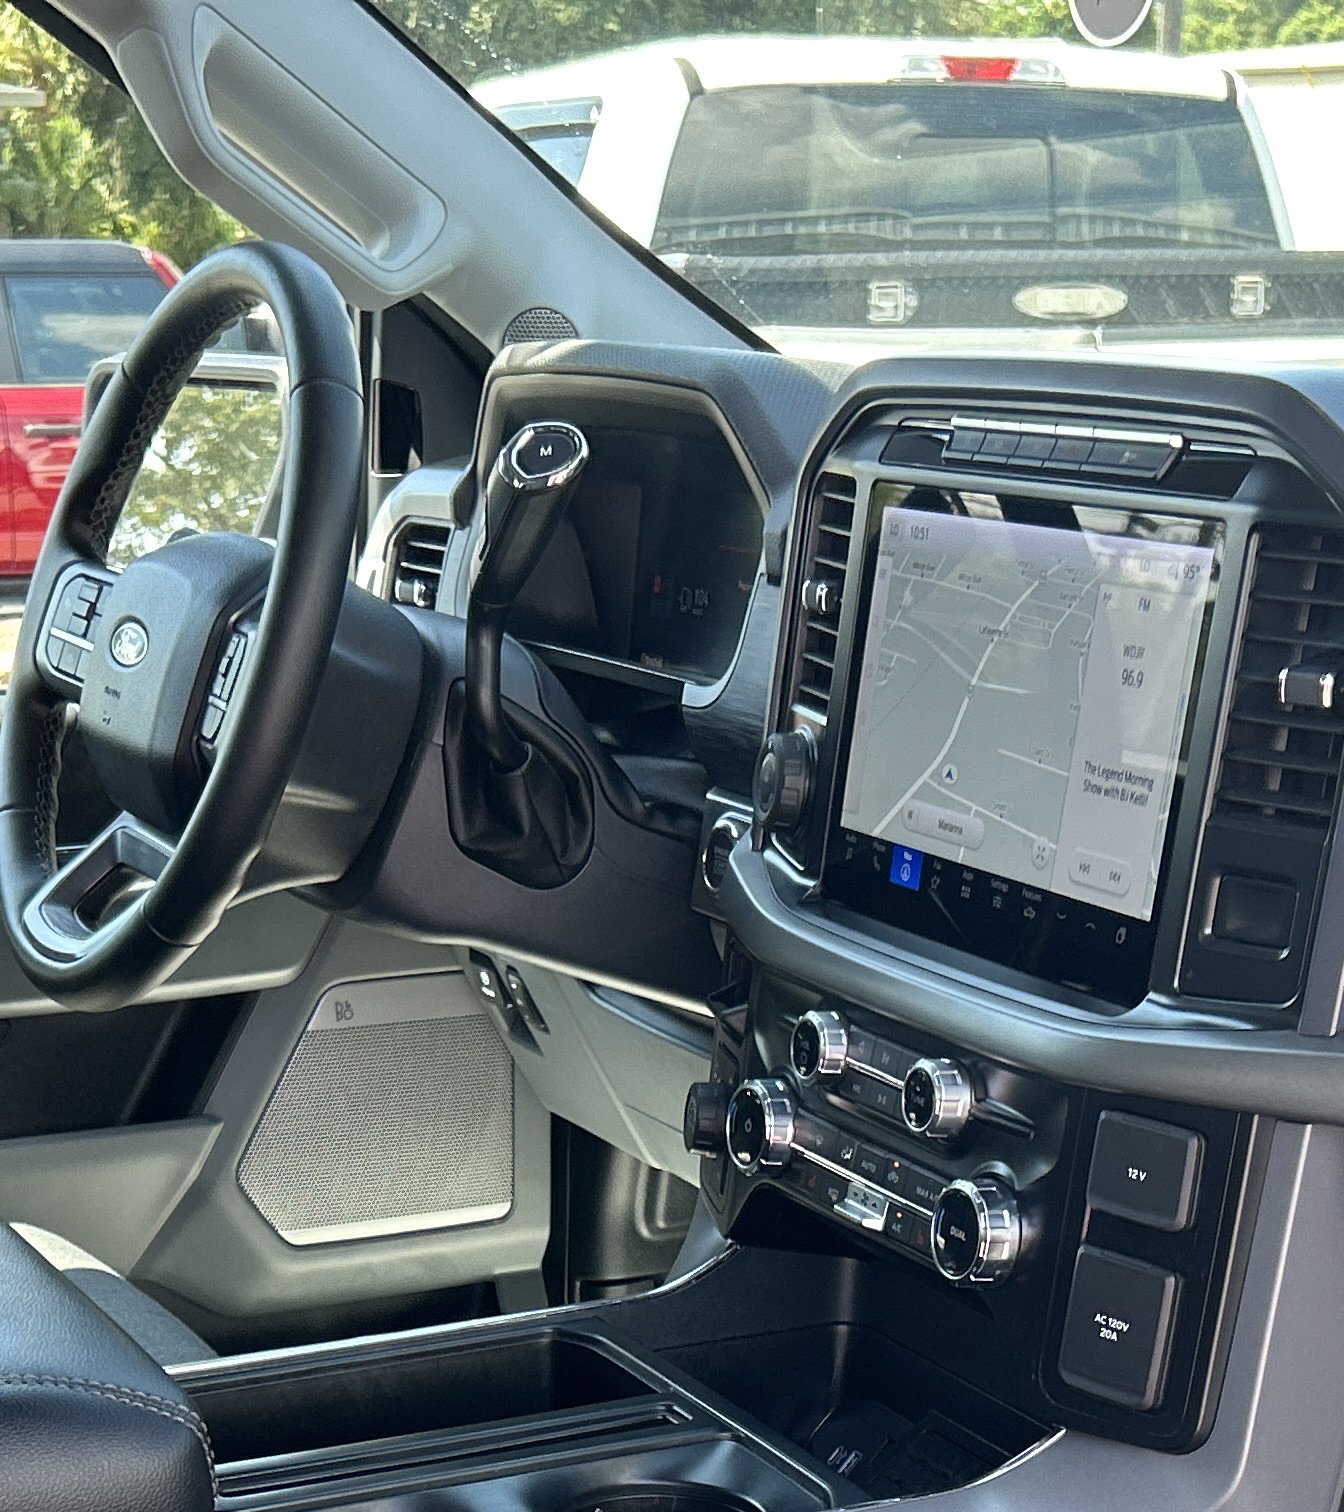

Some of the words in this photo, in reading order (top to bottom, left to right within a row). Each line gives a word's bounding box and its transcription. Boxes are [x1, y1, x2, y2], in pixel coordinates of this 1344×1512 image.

[540, 445, 552, 457] M
[1121, 668, 1144, 688] 96.9
[1084, 760, 1097, 775] The
[1094, 1313, 1107, 1325] AC
[1107, 1317, 1130, 1333] 120V
[1099, 1328, 1118, 1342] 20A
